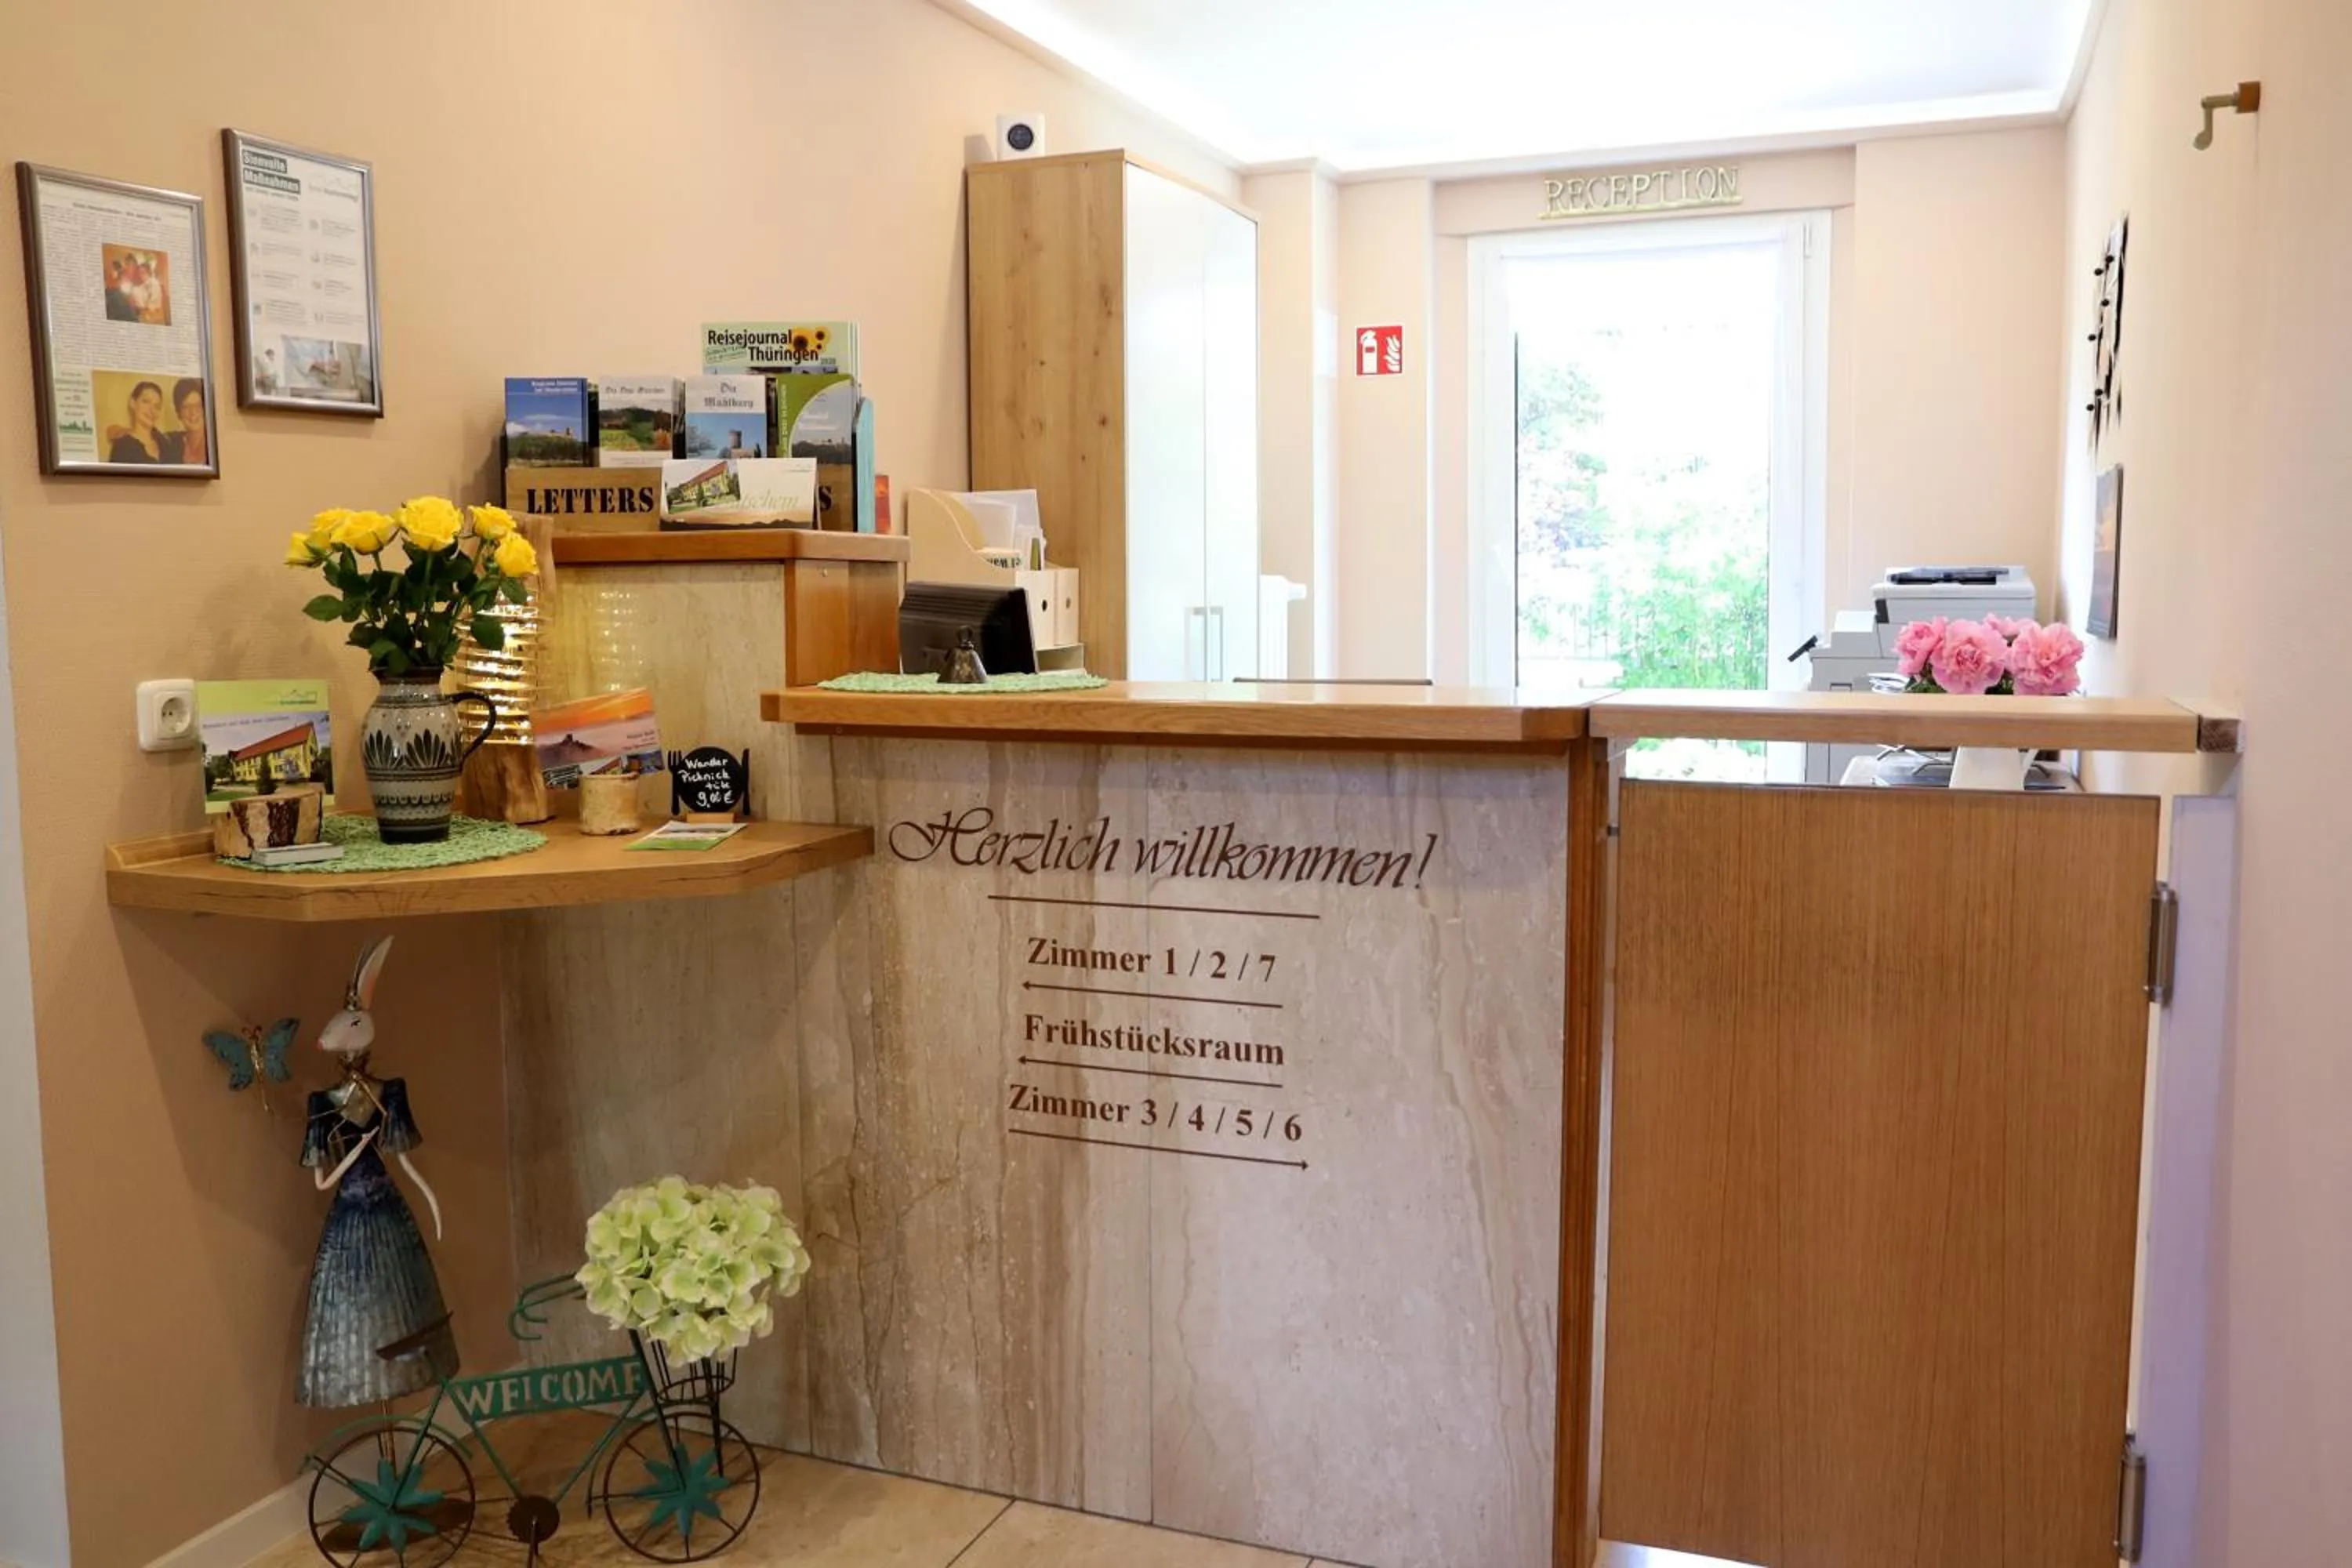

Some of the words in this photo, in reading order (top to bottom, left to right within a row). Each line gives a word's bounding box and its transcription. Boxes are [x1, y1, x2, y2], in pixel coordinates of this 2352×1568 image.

[1544, 165, 1740, 213] RECEPTION
[707, 328, 792, 348] Reisejournal
[748, 346, 819, 365] Thüringen
[526, 486, 654, 515] LETTERS
[684, 757, 728, 769] Wander
[888, 807, 1121, 874] Herzlich
[1134, 822, 1437, 890] willkommen!
[1027, 937, 1152, 974] Zimmer
[1024, 1014, 1285, 1065] Frühstücksraum
[1008, 1083, 1131, 1123] Zimmer
[455, 1362, 642, 1416] WELCOME
